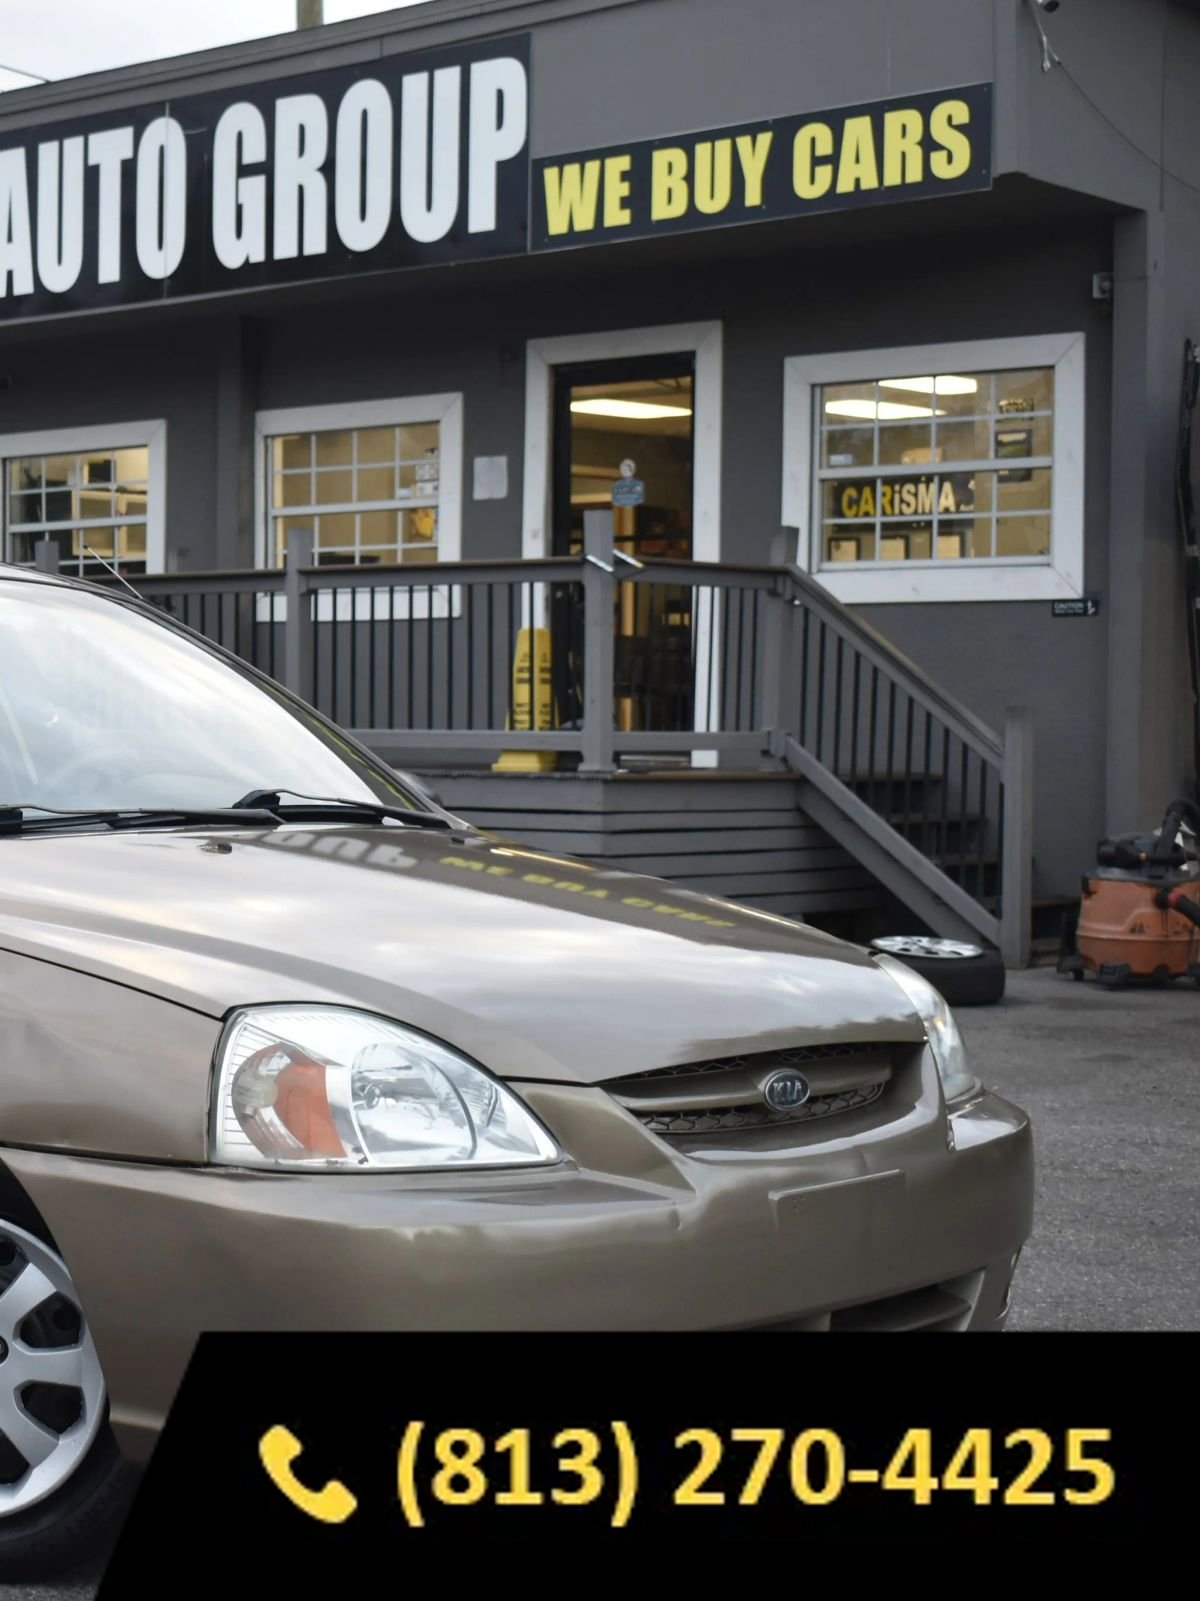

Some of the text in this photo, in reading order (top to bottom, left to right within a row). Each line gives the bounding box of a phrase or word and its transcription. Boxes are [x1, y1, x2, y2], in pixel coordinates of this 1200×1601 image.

[212, 56, 528, 270] GROUP
[543, 100, 971, 236] WE BUY CARS
